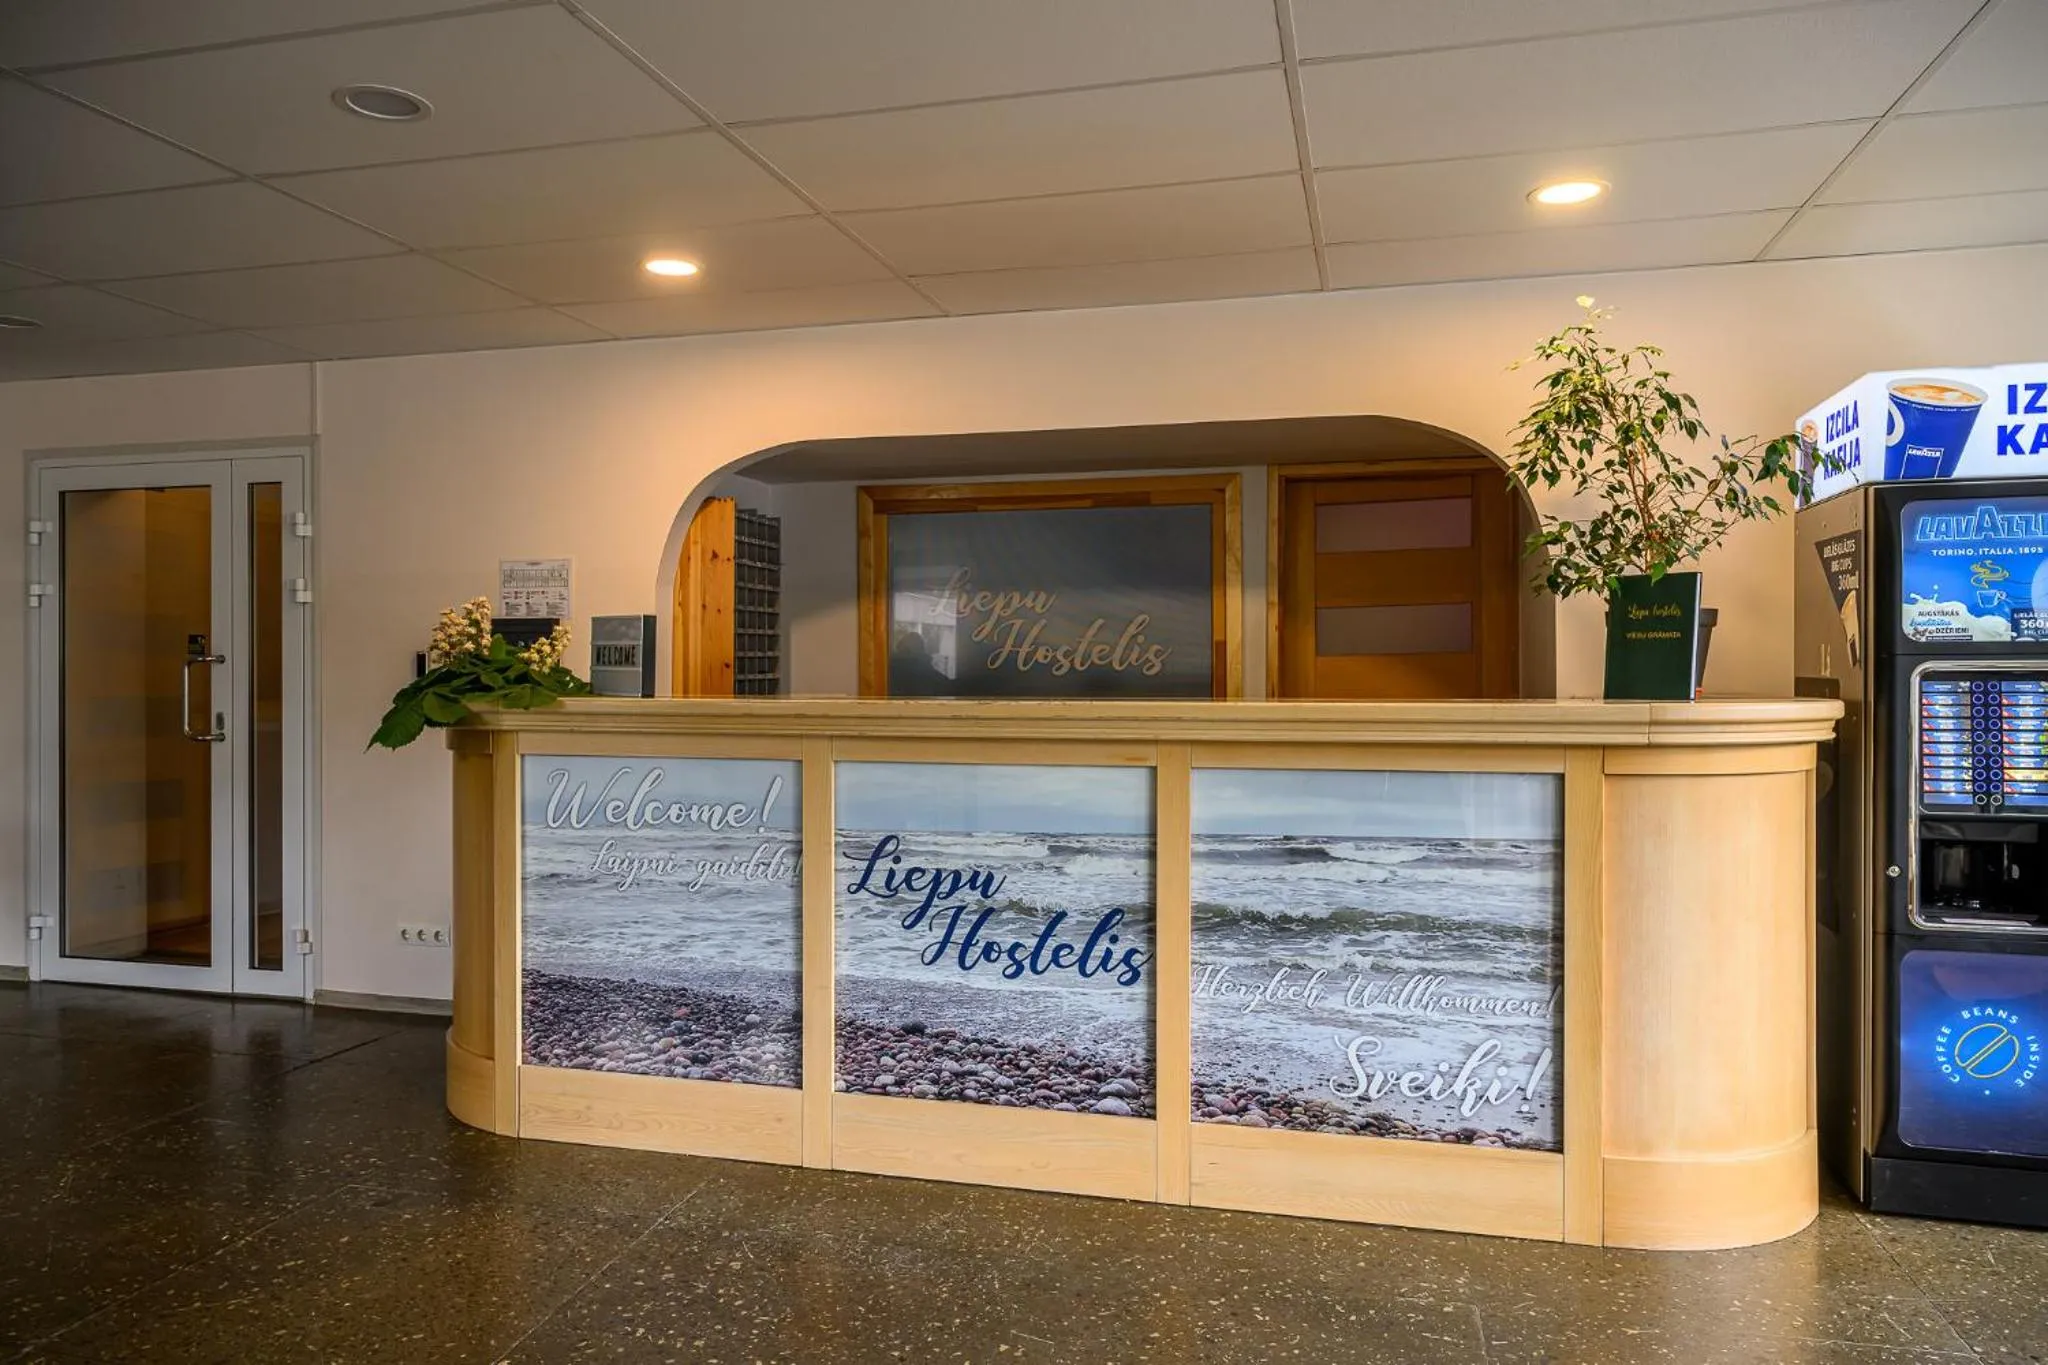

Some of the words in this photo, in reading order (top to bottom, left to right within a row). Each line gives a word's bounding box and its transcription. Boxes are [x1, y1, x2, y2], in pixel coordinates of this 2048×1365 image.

[1826, 399, 1859, 445] IZCILA
[927, 566, 1057, 642] Liepu
[596, 643, 637, 667] WELCOME
[986, 613, 1172, 676] Hostelis
[546, 766, 783, 834] Welcome!
[588, 839, 680, 891] Laipni
[842, 834, 1007, 930] Liepu
[921, 904, 1154, 986] Hostelis
[1192, 964, 1328, 1014] Herzlich
[1329, 1034, 1551, 1118] Sveiki!
[1936, 1025, 1960, 1083] COFFEE
[1961, 1007, 2019, 1025] BEANS
[2014, 1035, 2041, 1088] INSIDE
